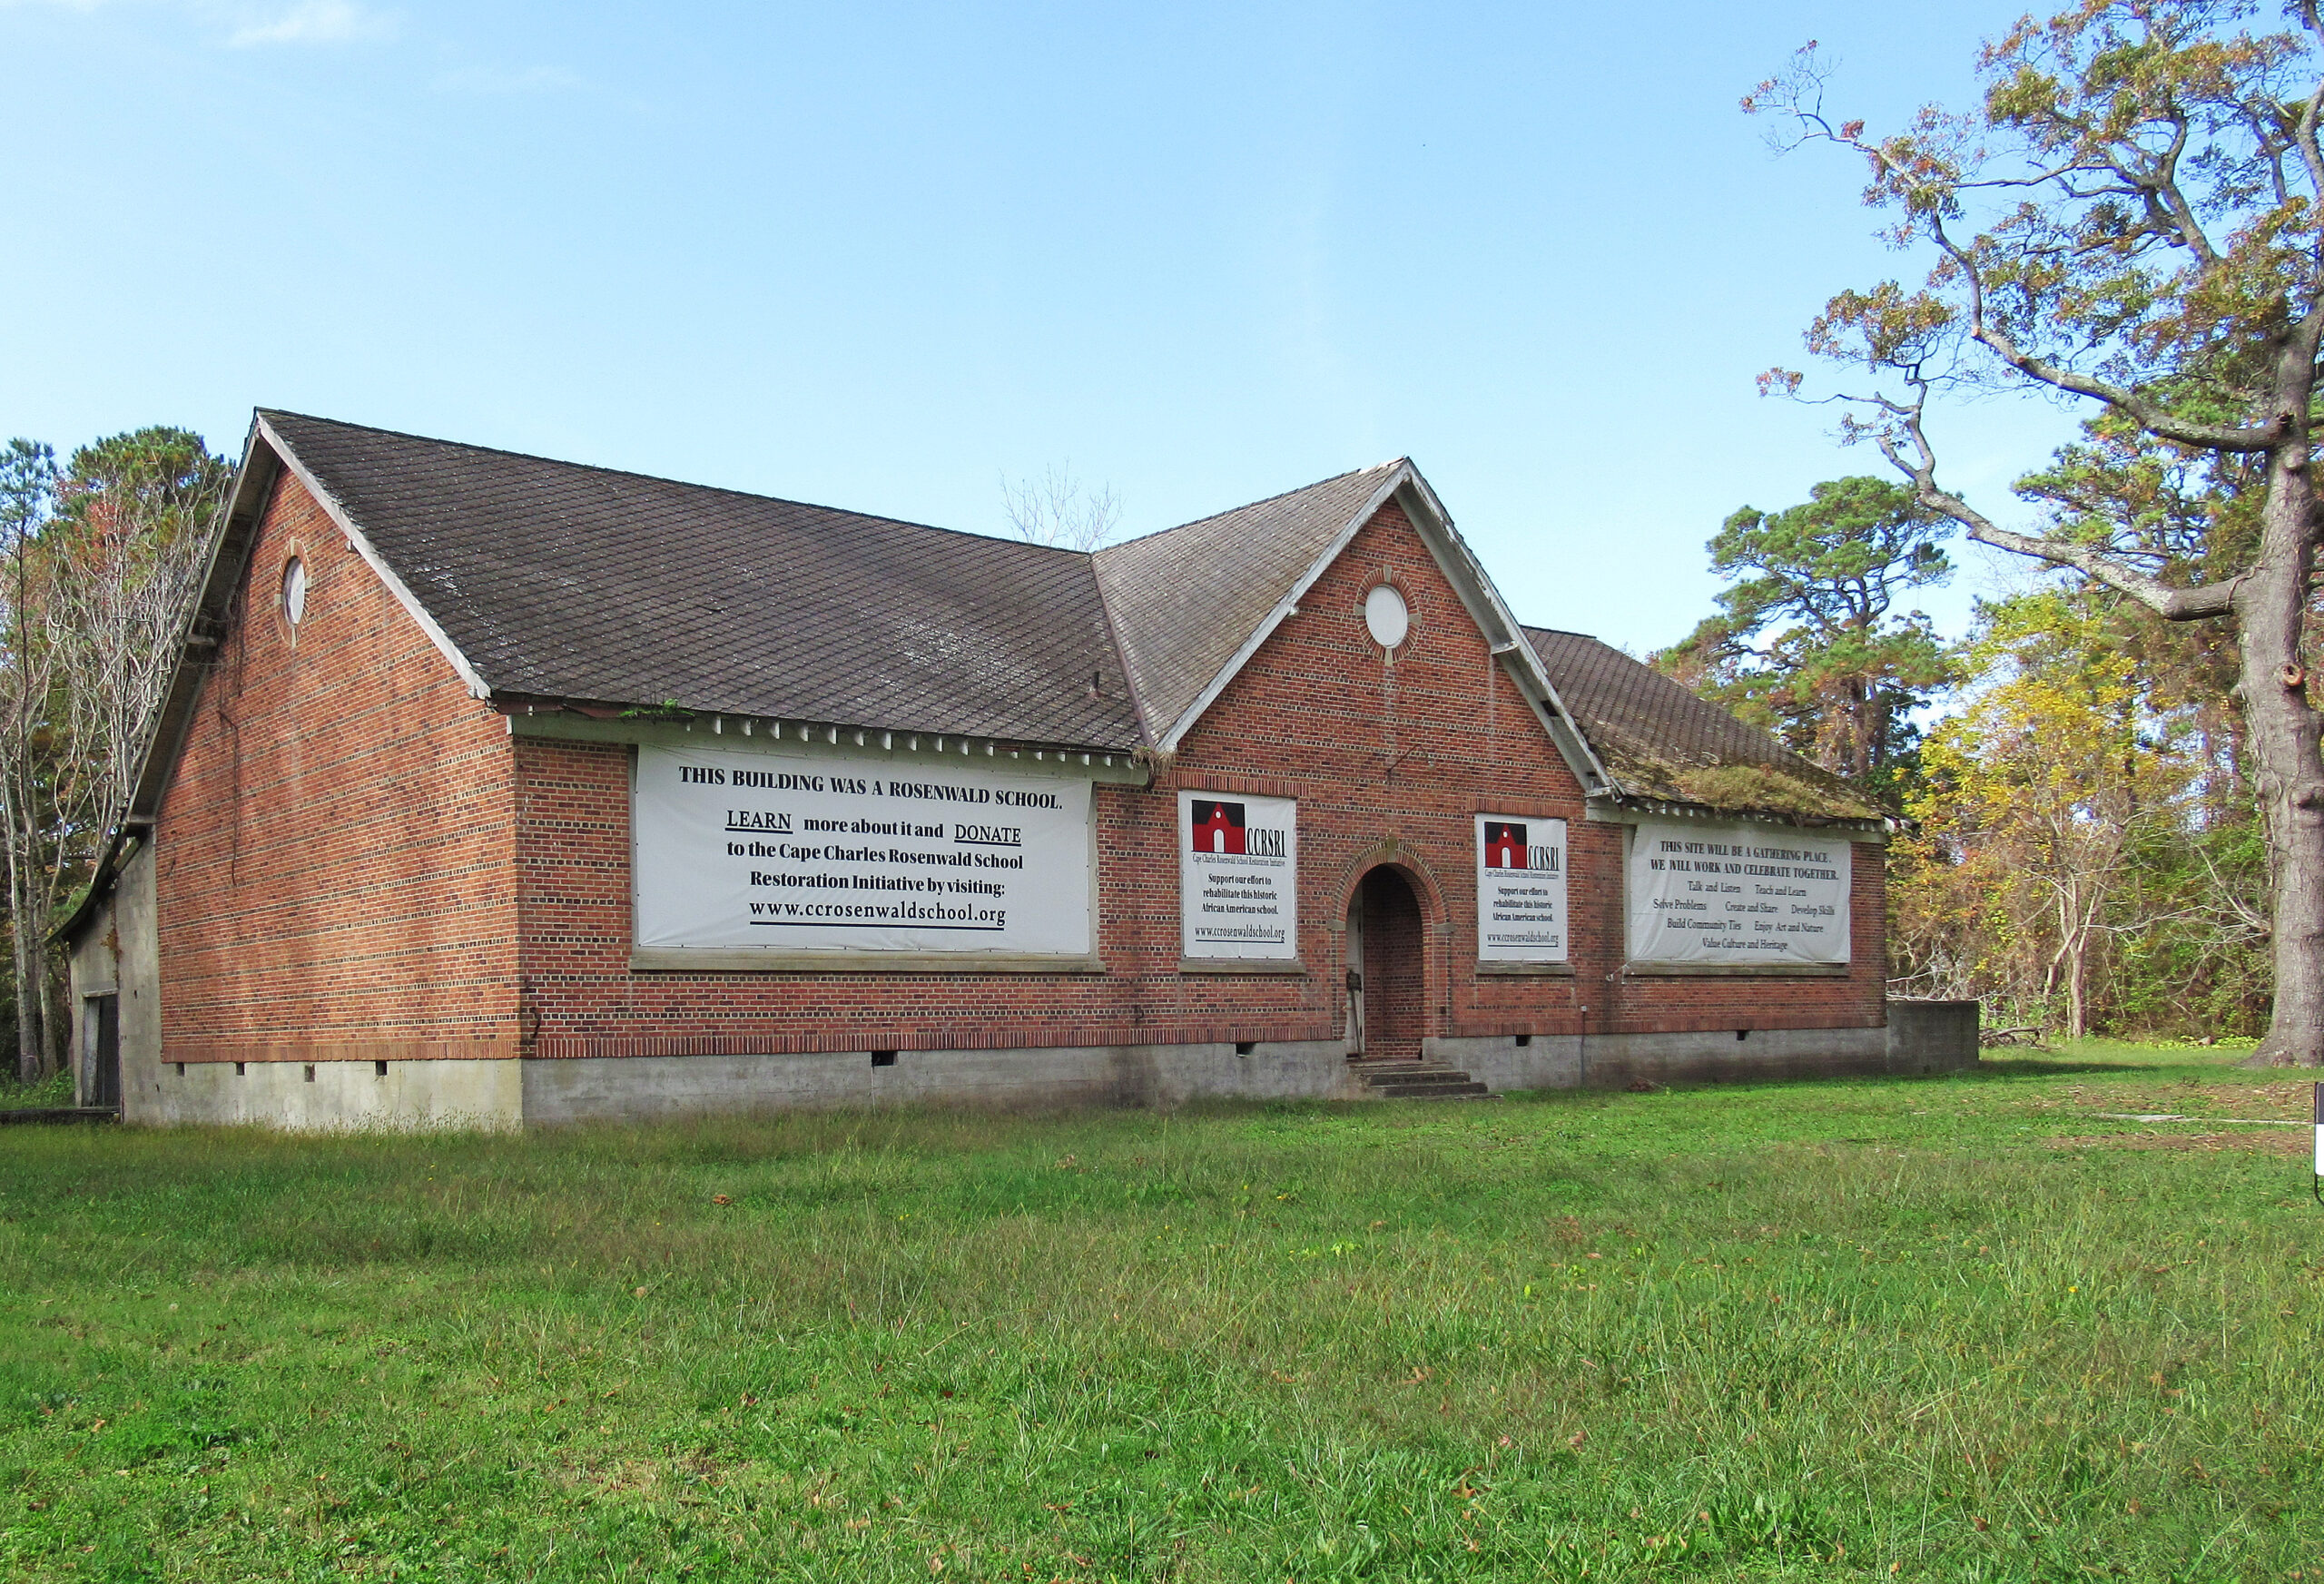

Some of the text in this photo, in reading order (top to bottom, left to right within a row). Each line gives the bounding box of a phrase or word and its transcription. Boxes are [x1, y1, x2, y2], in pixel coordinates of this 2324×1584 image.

[679, 765, 1063, 810] THIS BUILDING WAS A ROSENWALD SCHOOL.
[725, 810, 1021, 843] LEARN more about it and DONATE
[1246, 828, 1285, 857] CCRSRI
[727, 841, 1023, 870] to the Cape Charles Rosenwald School
[1193, 853, 1201, 864] Cape
[1529, 846, 1560, 871] CCRSRI
[1660, 841, 1831, 862] THIS SITE WILL BE A GATHERING PLACE.
[1650, 859, 1839, 880] WE WILL WORK AND CELEBRATE TOGETHER.
[750, 871, 1005, 898] Restoration Initiative by visiting:
[1208, 873, 1234, 885] Support
[1247, 875, 1265, 884] effort
[1265, 877, 1271, 885] to
[1706, 882, 1718, 891] and
[1721, 882, 1740, 892] Listen
[1203, 888, 1277, 900] rehabilitate this historic
[1755, 884, 1807, 896] Teach and Learn
[750, 900, 1006, 925] www.ccrosenwaldschool.org
[1202, 903, 1278, 914] African American school.
[1653, 899, 1707, 910] Solve Problems
[1725, 901, 1746, 911] Create
[1668, 918, 1741, 932] Build Community Ties
[1195, 924, 1285, 943] www.ccrosenwaldschool.org
[1702, 938, 1720, 948] Value
[1722, 939, 1746, 948] Culture
